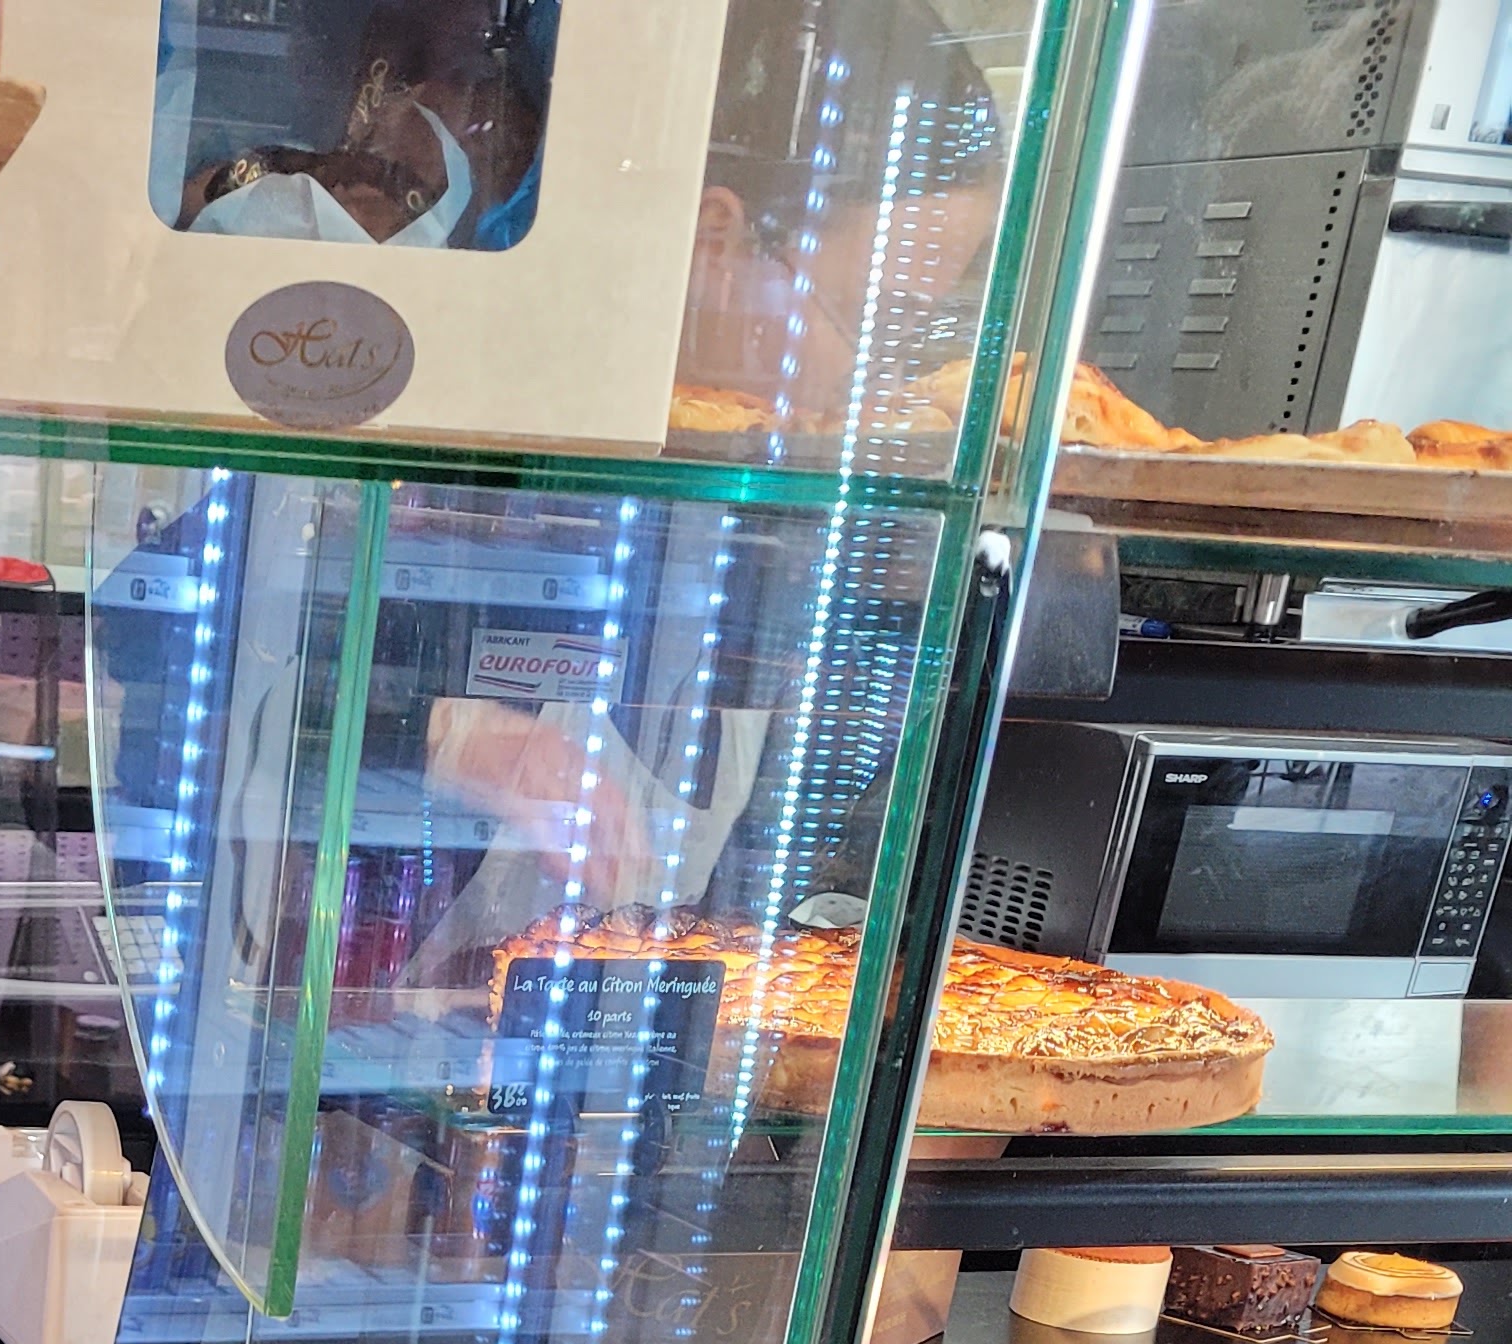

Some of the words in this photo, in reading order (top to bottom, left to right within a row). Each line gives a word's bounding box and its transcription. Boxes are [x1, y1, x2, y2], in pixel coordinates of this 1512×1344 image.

[1164, 772, 1209, 783] SHARP
[513, 975, 533, 992] La
[578, 978, 598, 993] au
[601, 974, 643, 993] Citron
[646, 974, 718, 999] Meringuée
[586, 1009, 602, 1022] 10
[602, 1010, 633, 1028] parts
